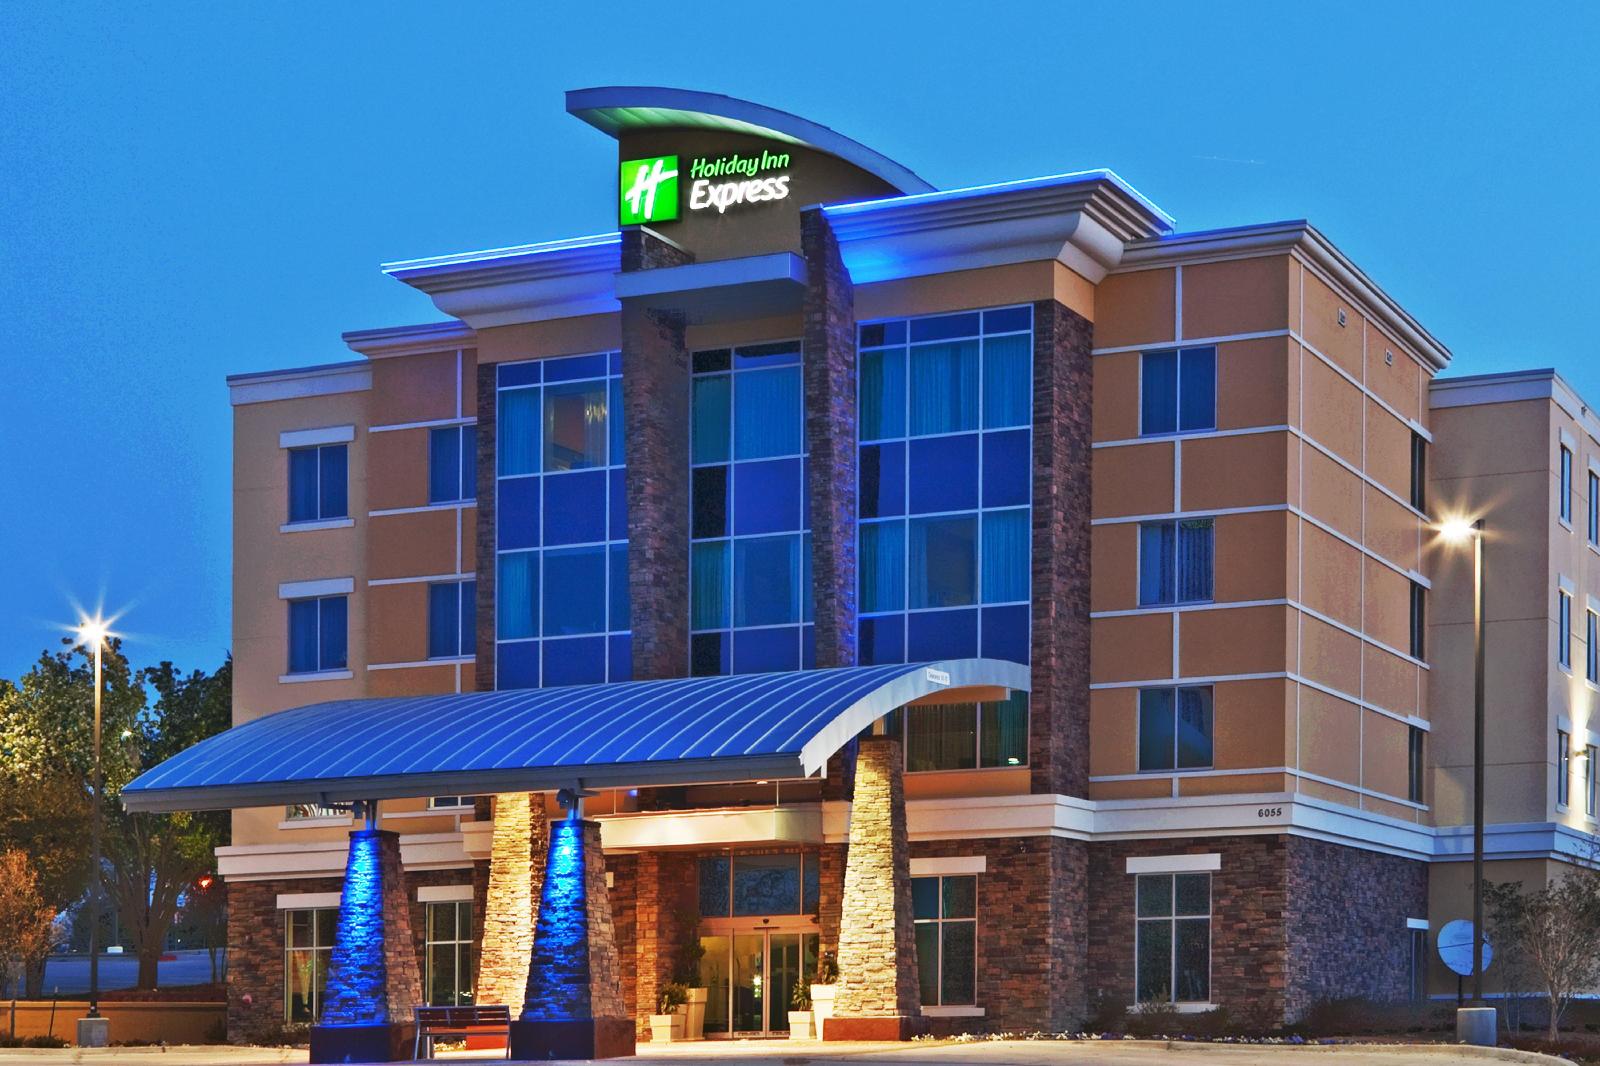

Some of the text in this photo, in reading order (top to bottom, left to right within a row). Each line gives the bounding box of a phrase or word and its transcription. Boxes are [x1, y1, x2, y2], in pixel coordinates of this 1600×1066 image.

[690, 150, 790, 179] Holiday Inn
[625, 159, 679, 220] H
[689, 175, 790, 214] Express
[1257, 807, 1282, 818] 6055
